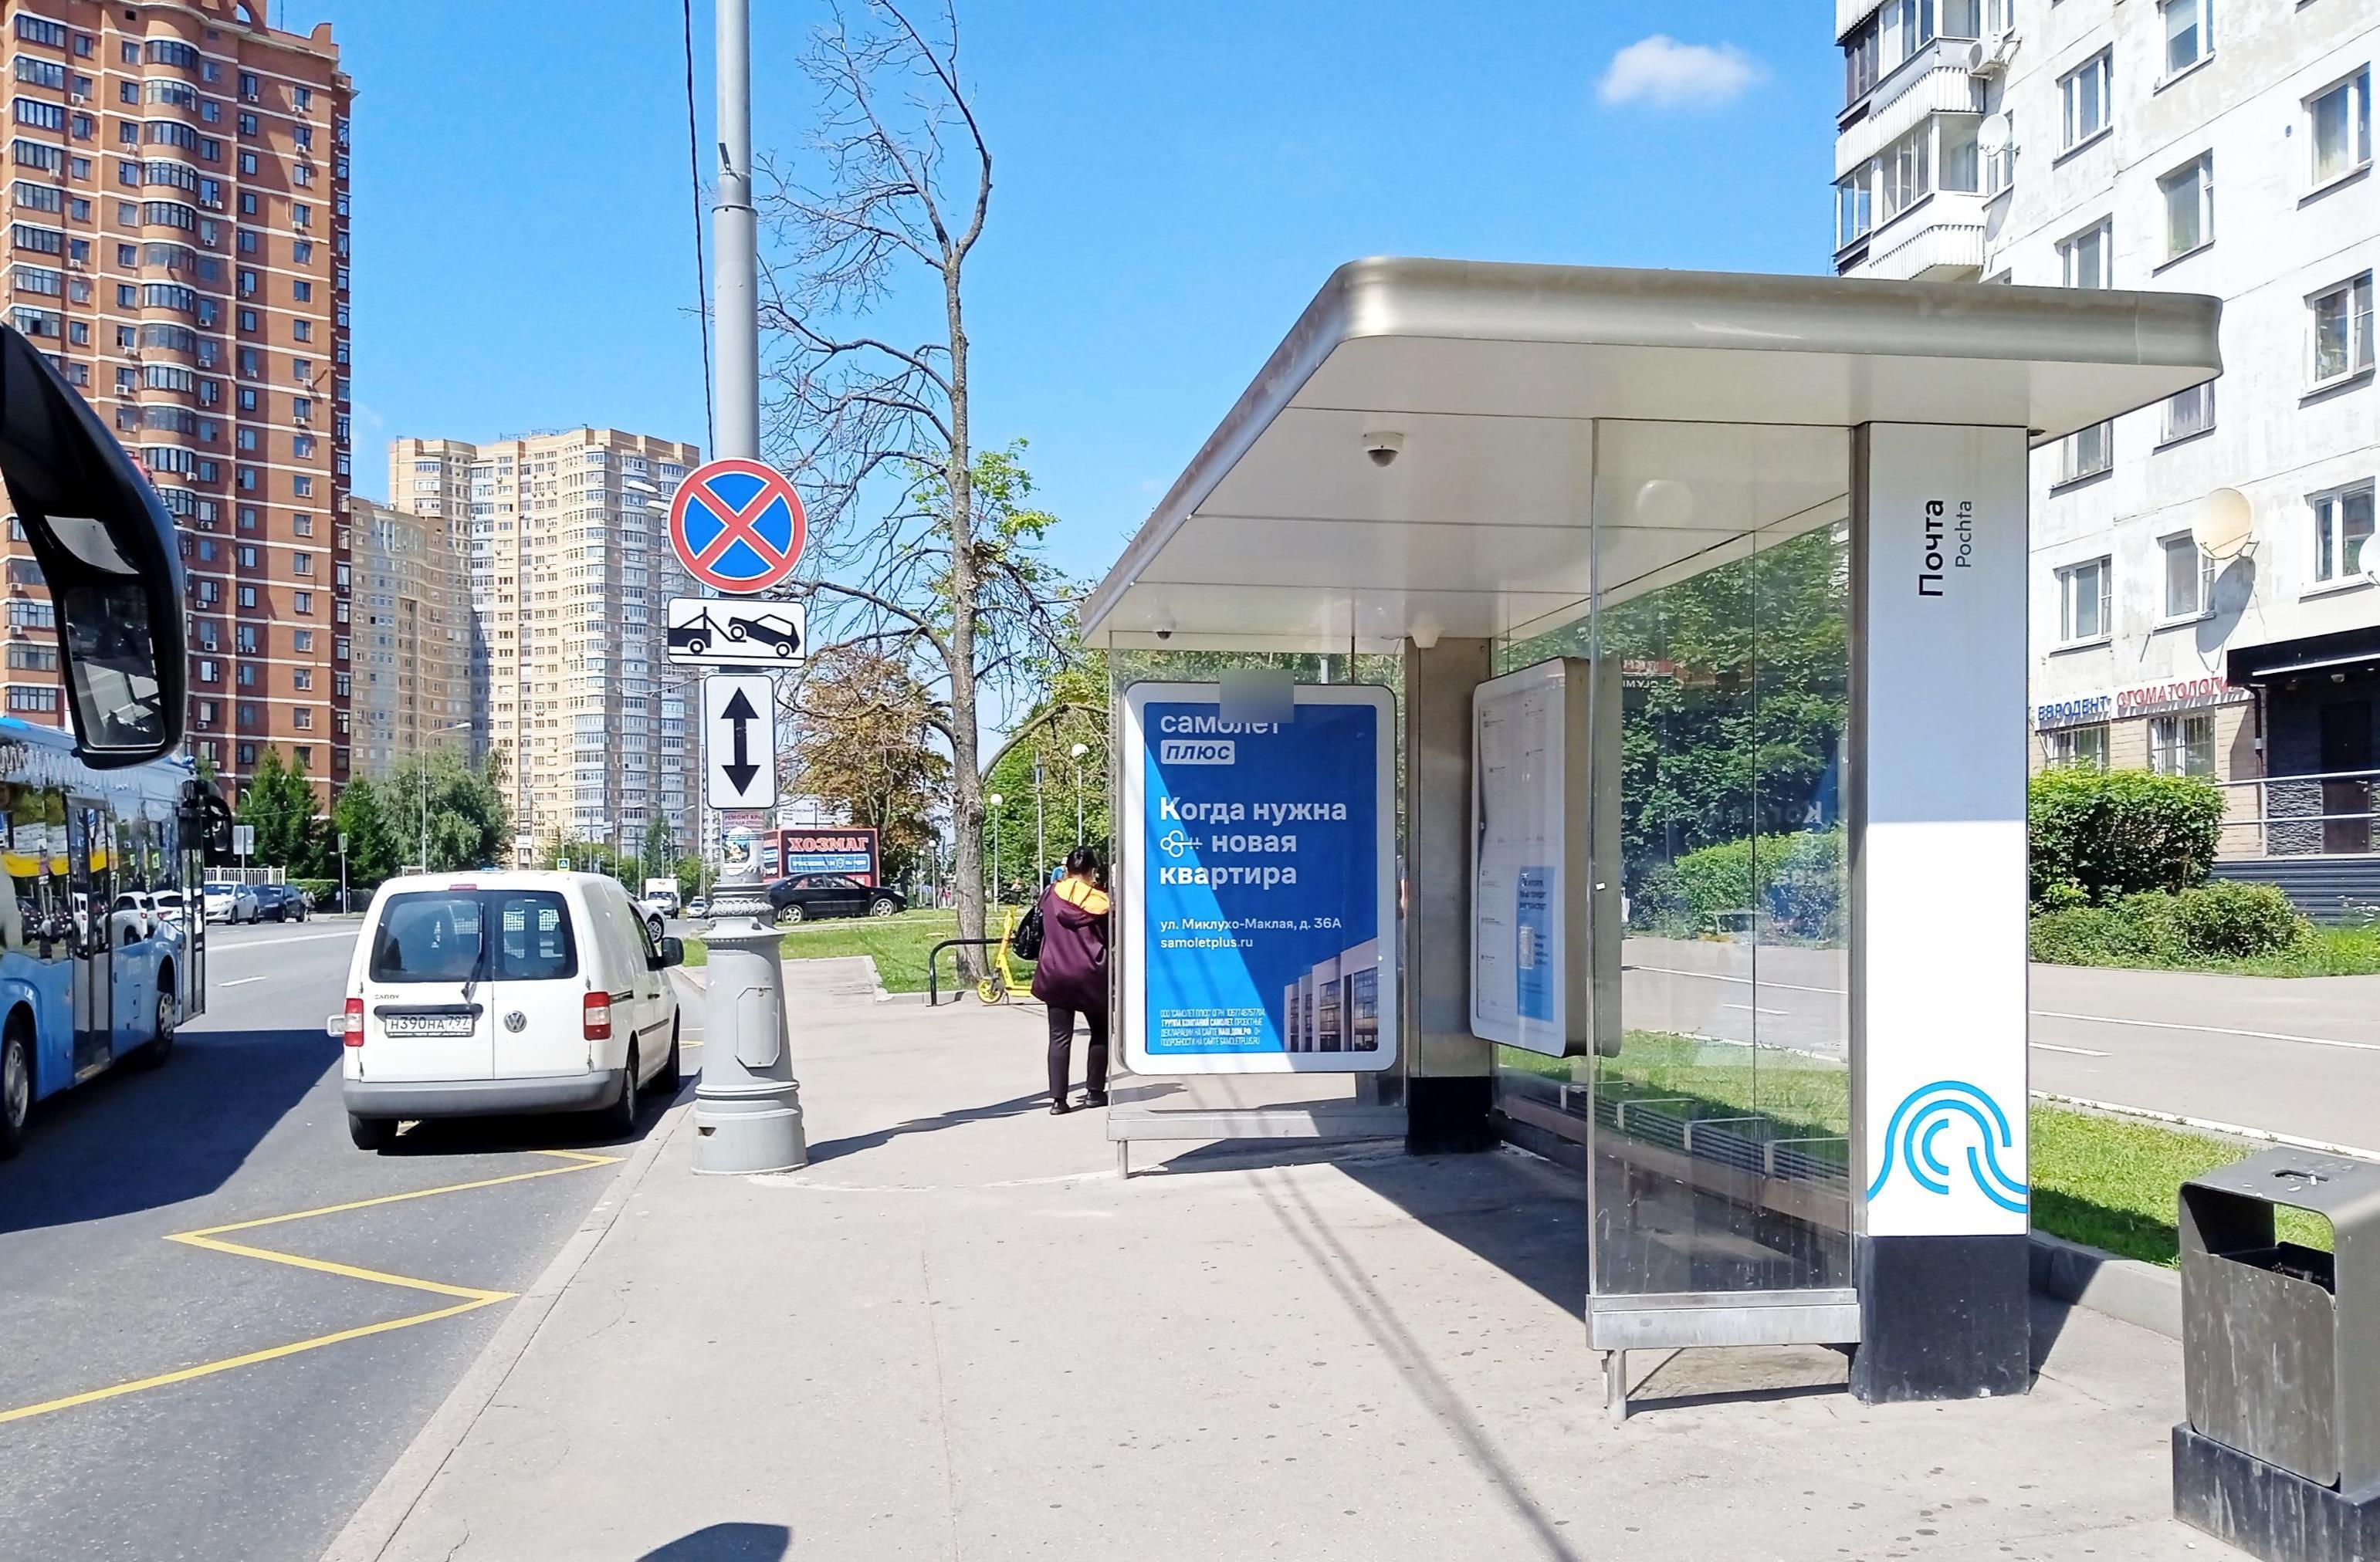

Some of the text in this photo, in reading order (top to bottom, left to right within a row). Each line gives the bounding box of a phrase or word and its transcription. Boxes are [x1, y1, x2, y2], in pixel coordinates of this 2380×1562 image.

[1955, 501, 1972, 567] Pochta
[1918, 500, 1944, 597] Почта
[2038, 676, 2229, 721] ЕВРОДЕНТ СТОМАТОЛОГИ
[1160, 796, 1347, 826] Когда нужна
[787, 837, 869, 852] ХОЗМАГ
[1211, 834, 1298, 853] новая
[1160, 867, 1298, 890] квартира
[1160, 918, 1342, 932] ул. Миклухо-Маклая, д. 36А
[1160, 936, 1254, 950] samoletplus.ru
